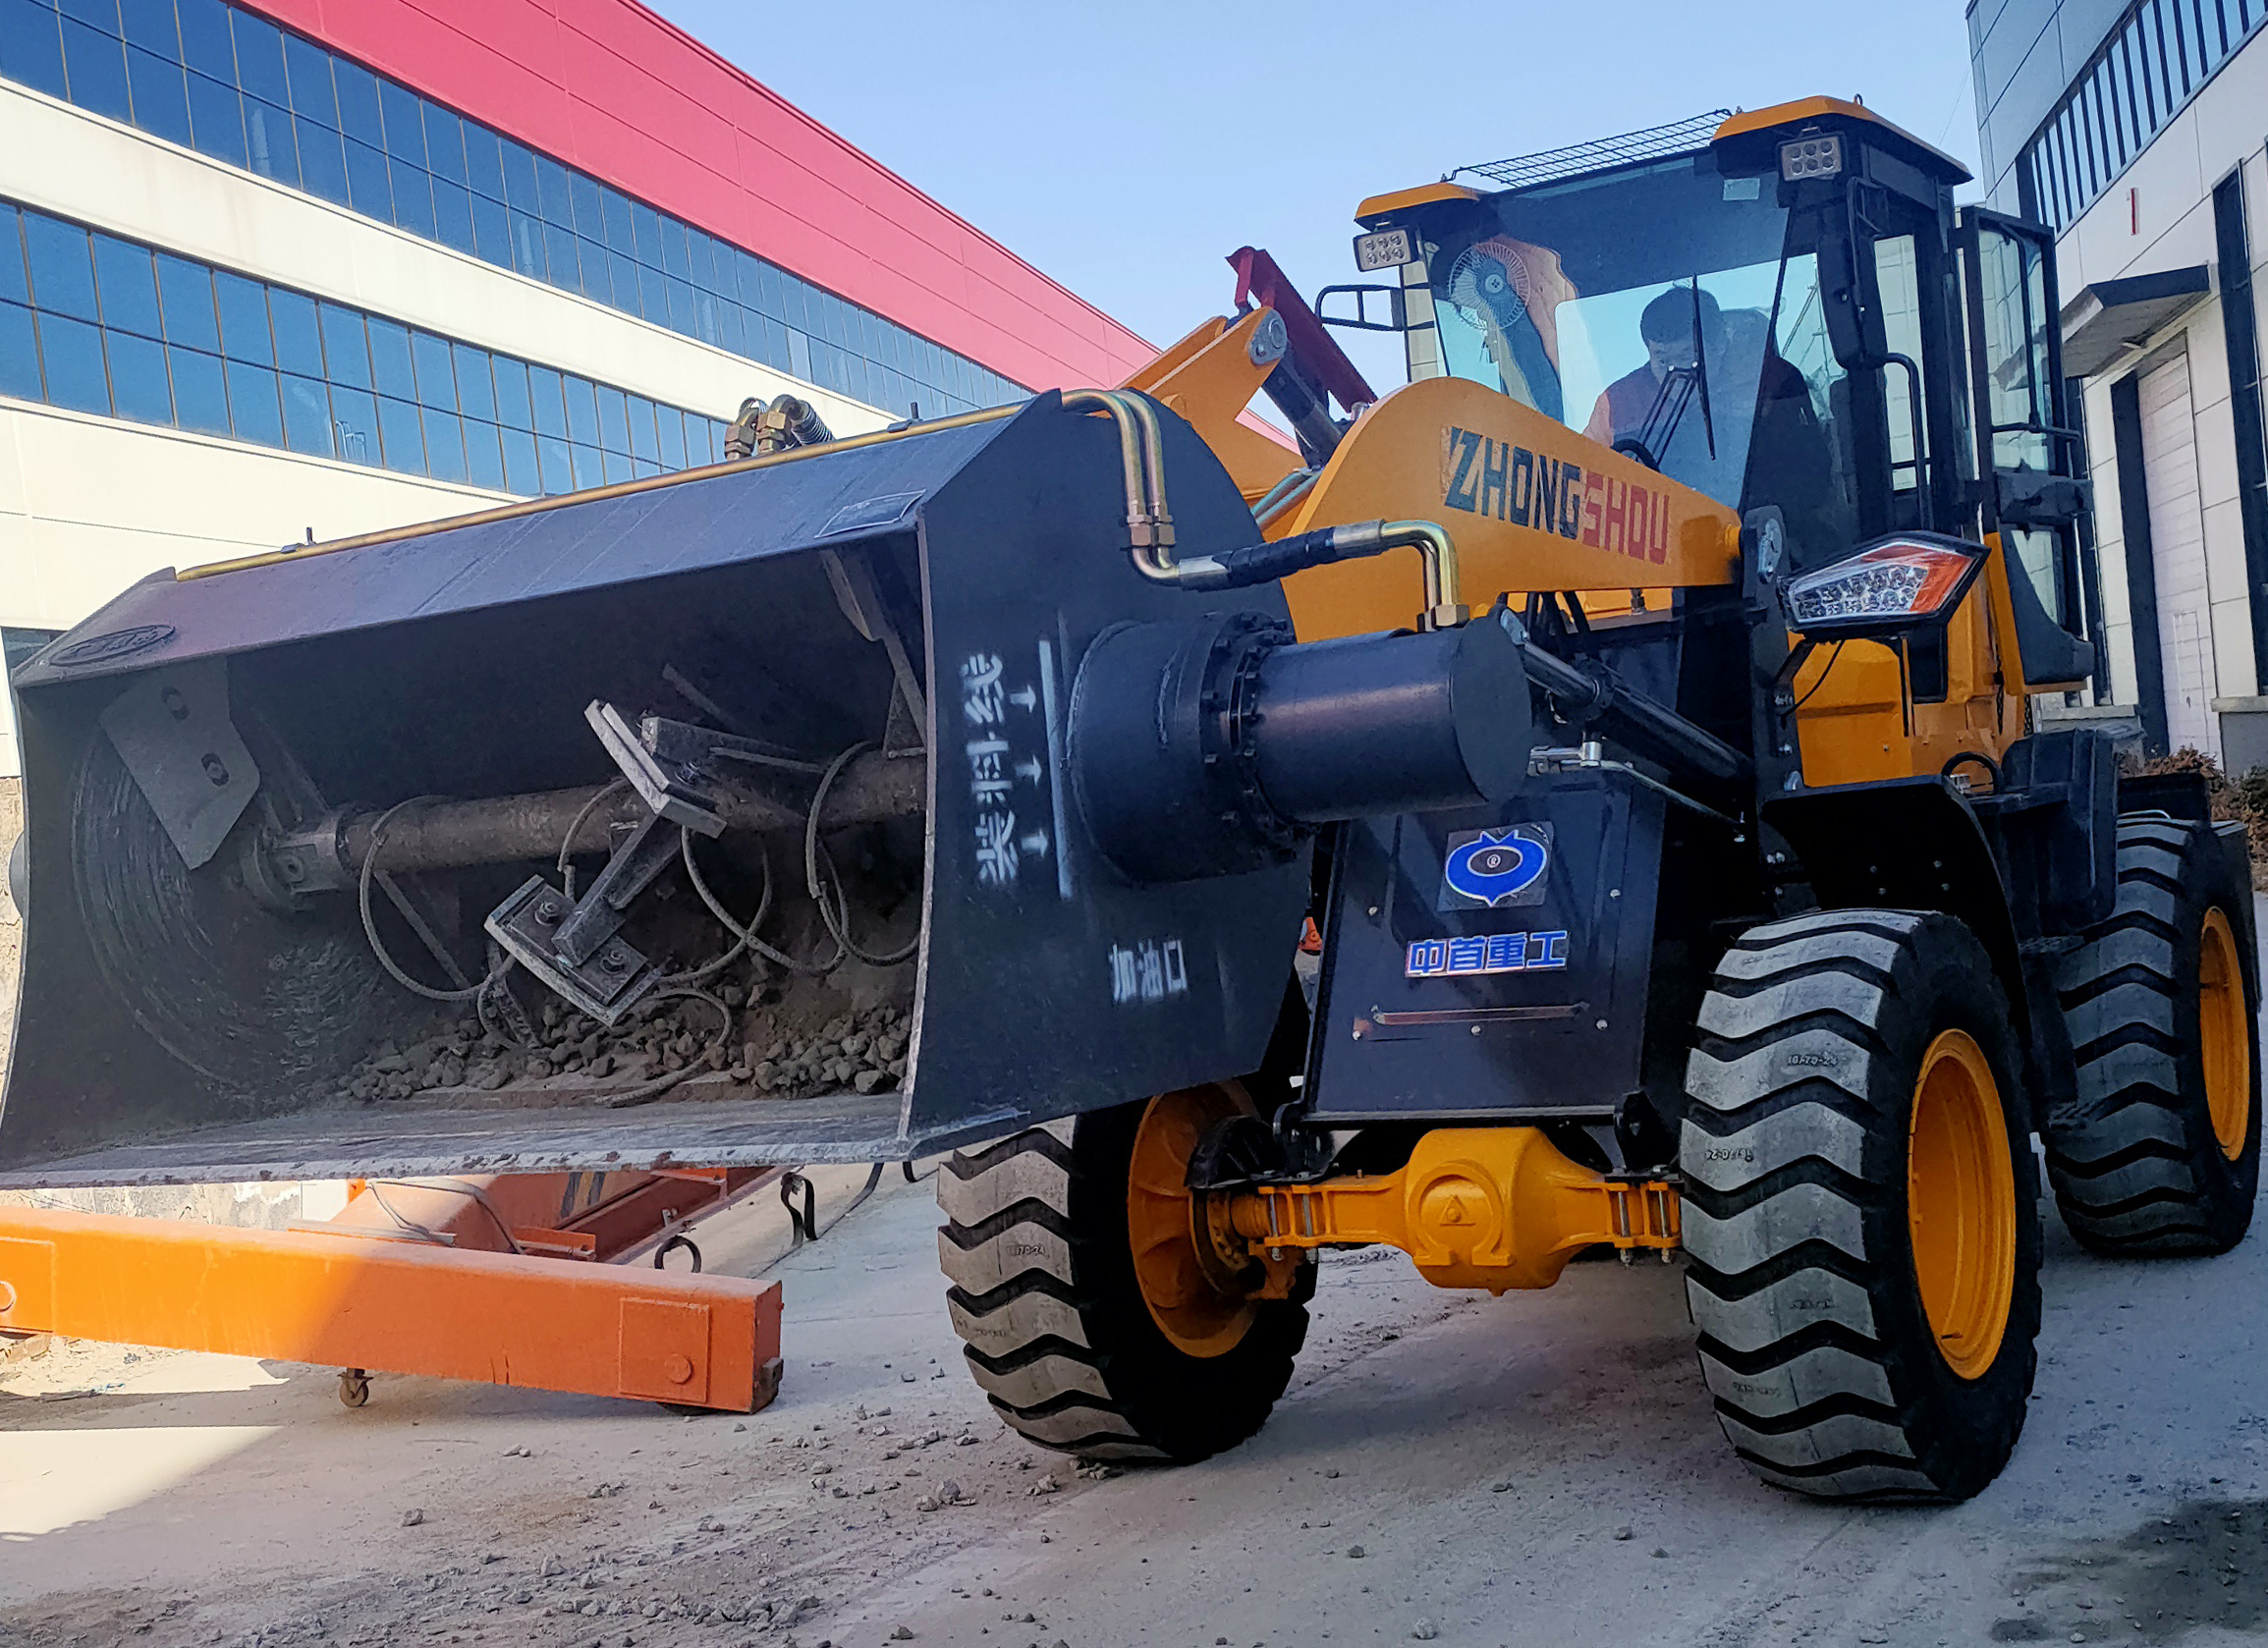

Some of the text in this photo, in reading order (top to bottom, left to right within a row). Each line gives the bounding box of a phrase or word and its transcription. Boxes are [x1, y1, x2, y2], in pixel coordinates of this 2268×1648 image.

[1444, 426, 1670, 566] ZHONGSHOU
[1407, 930, 1568, 977] 中首重工
